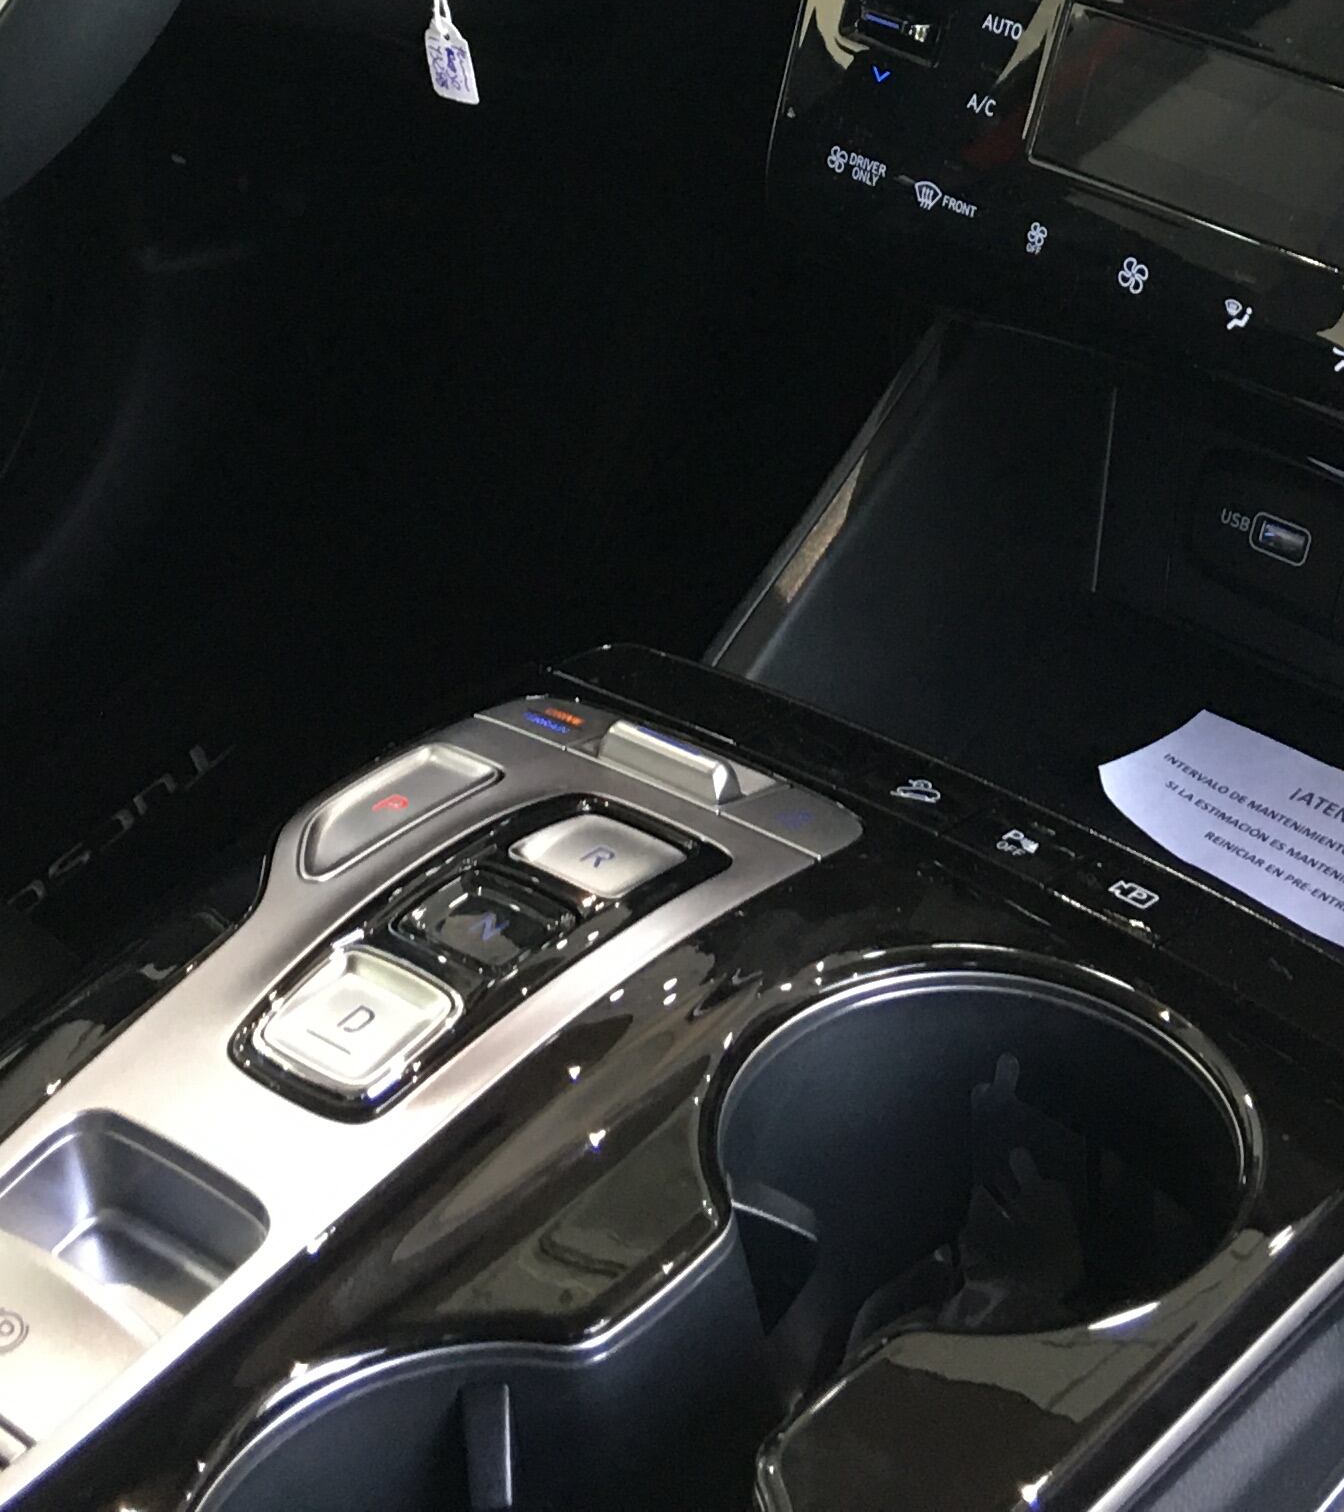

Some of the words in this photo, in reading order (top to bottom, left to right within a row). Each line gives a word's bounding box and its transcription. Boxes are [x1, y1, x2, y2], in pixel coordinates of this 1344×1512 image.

[982, 14, 1023, 41] AUTO
[967, 94, 997, 117] A/C
[849, 152, 886, 178] DRIVER
[851, 167, 879, 187] ONLY
[942, 195, 977, 218] FRONT
[1220, 508, 1251, 532] USB
[1163, 753, 1229, 795] INTERVALO
[1229, 790, 1247, 804] DE
[372, 794, 409, 812] P
[1165, 780, 1179, 792] SI
[1178, 787, 1194, 802] LA
[1269, 839, 1286, 851] ES
[578, 845, 615, 869] R
[1204, 831, 1265, 867] REINICIAR
[1265, 863, 1285, 877] EN
[468, 912, 510, 941] N
[336, 1005, 376, 1033] D
